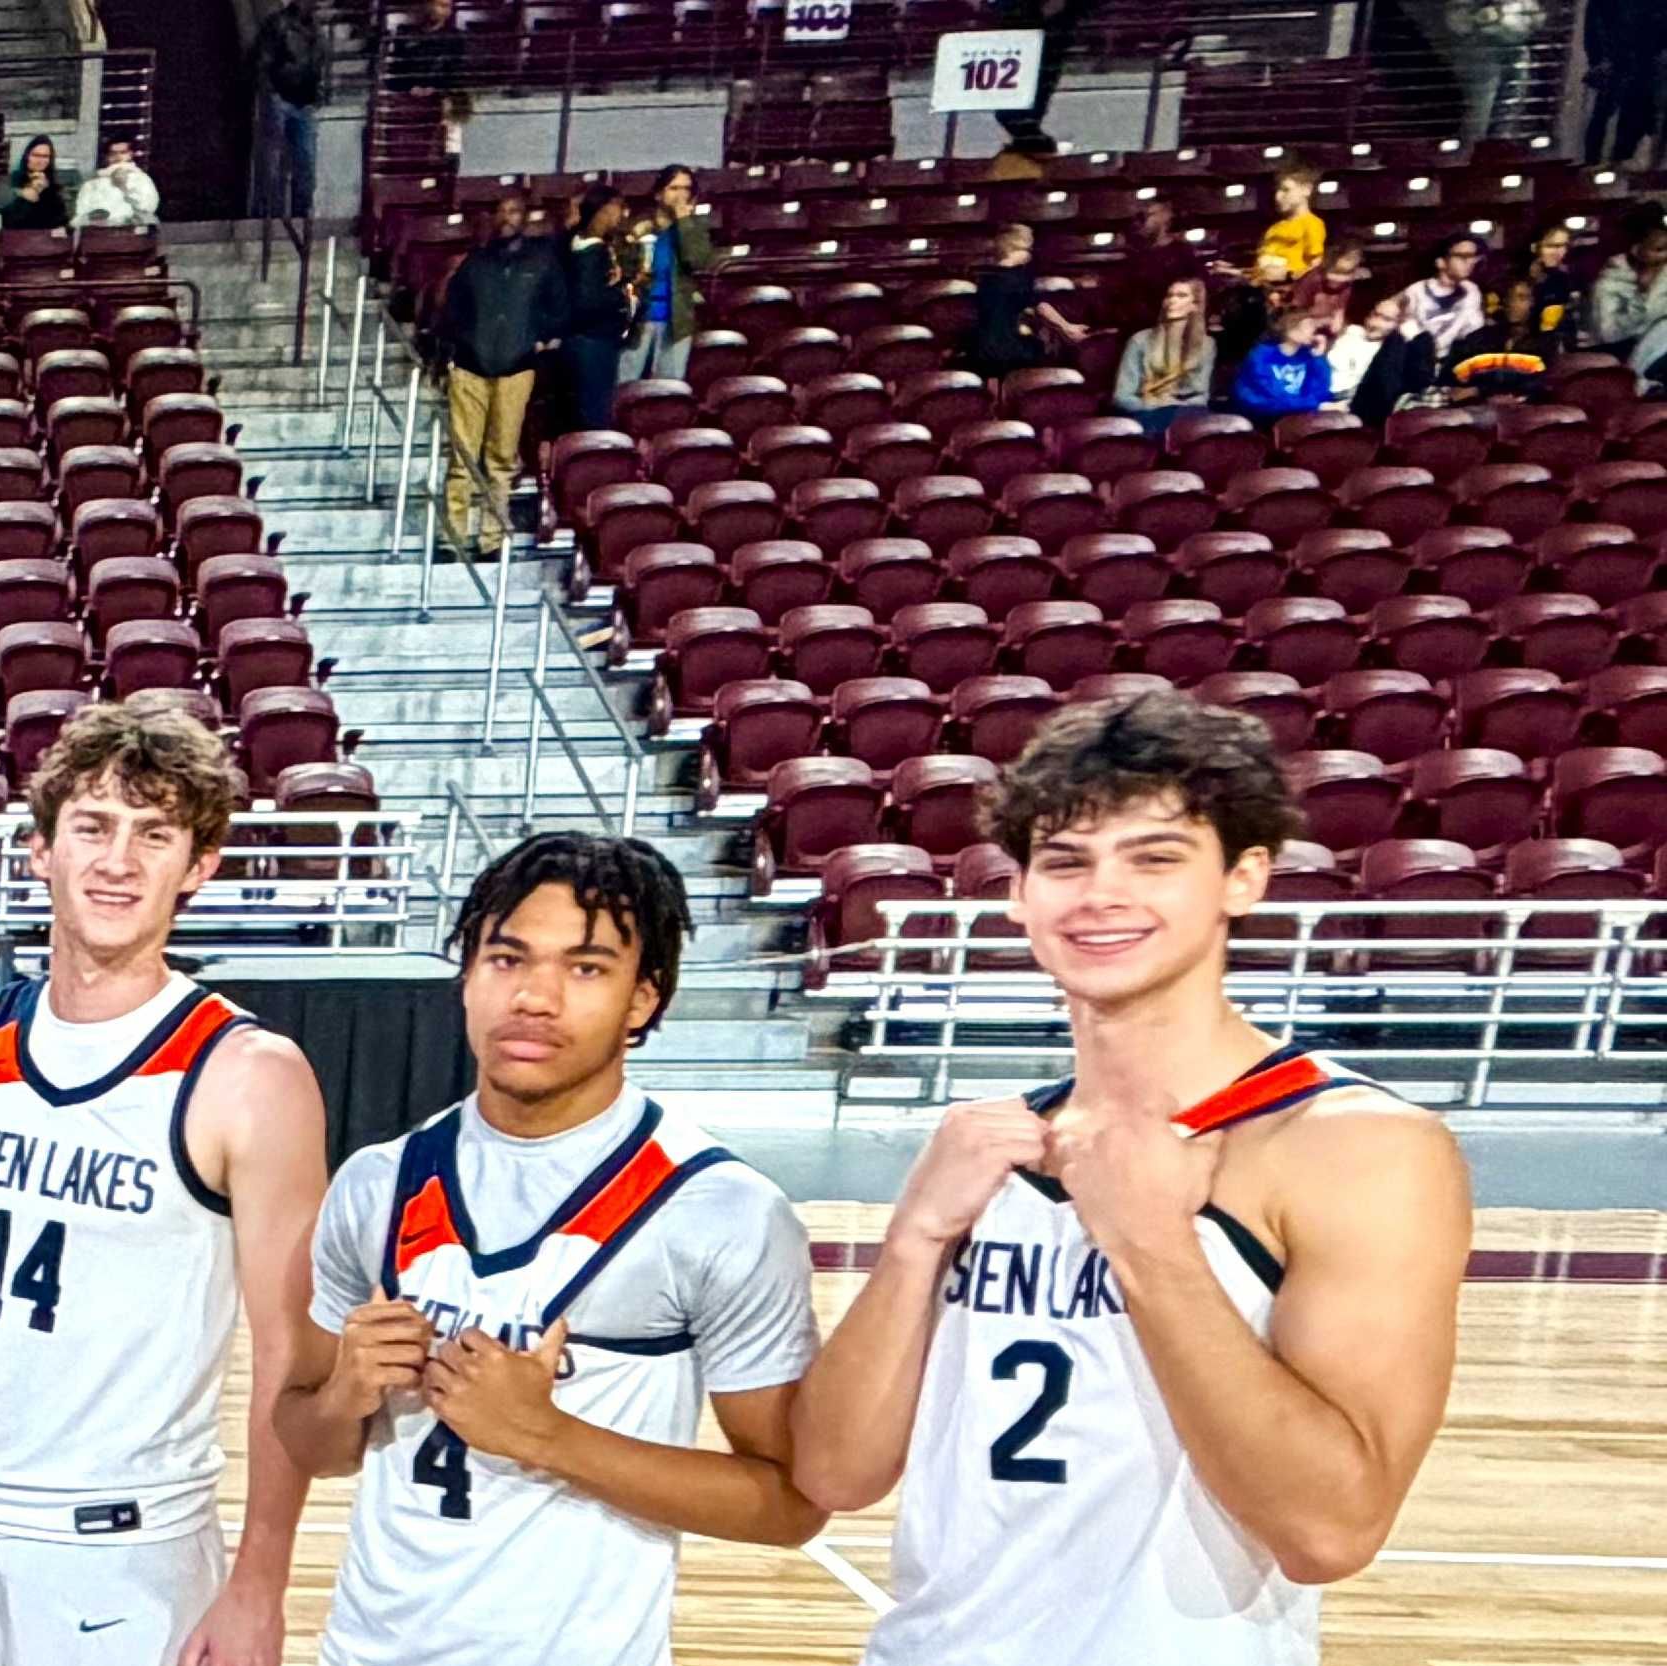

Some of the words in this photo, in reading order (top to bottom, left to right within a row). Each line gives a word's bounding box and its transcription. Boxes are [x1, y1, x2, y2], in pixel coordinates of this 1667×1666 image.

[960, 58, 1021, 90] 102
[39, 1141, 158, 1214] LAKES
[990, 1340, 1074, 1484] 2
[412, 1419, 472, 1519] 4
